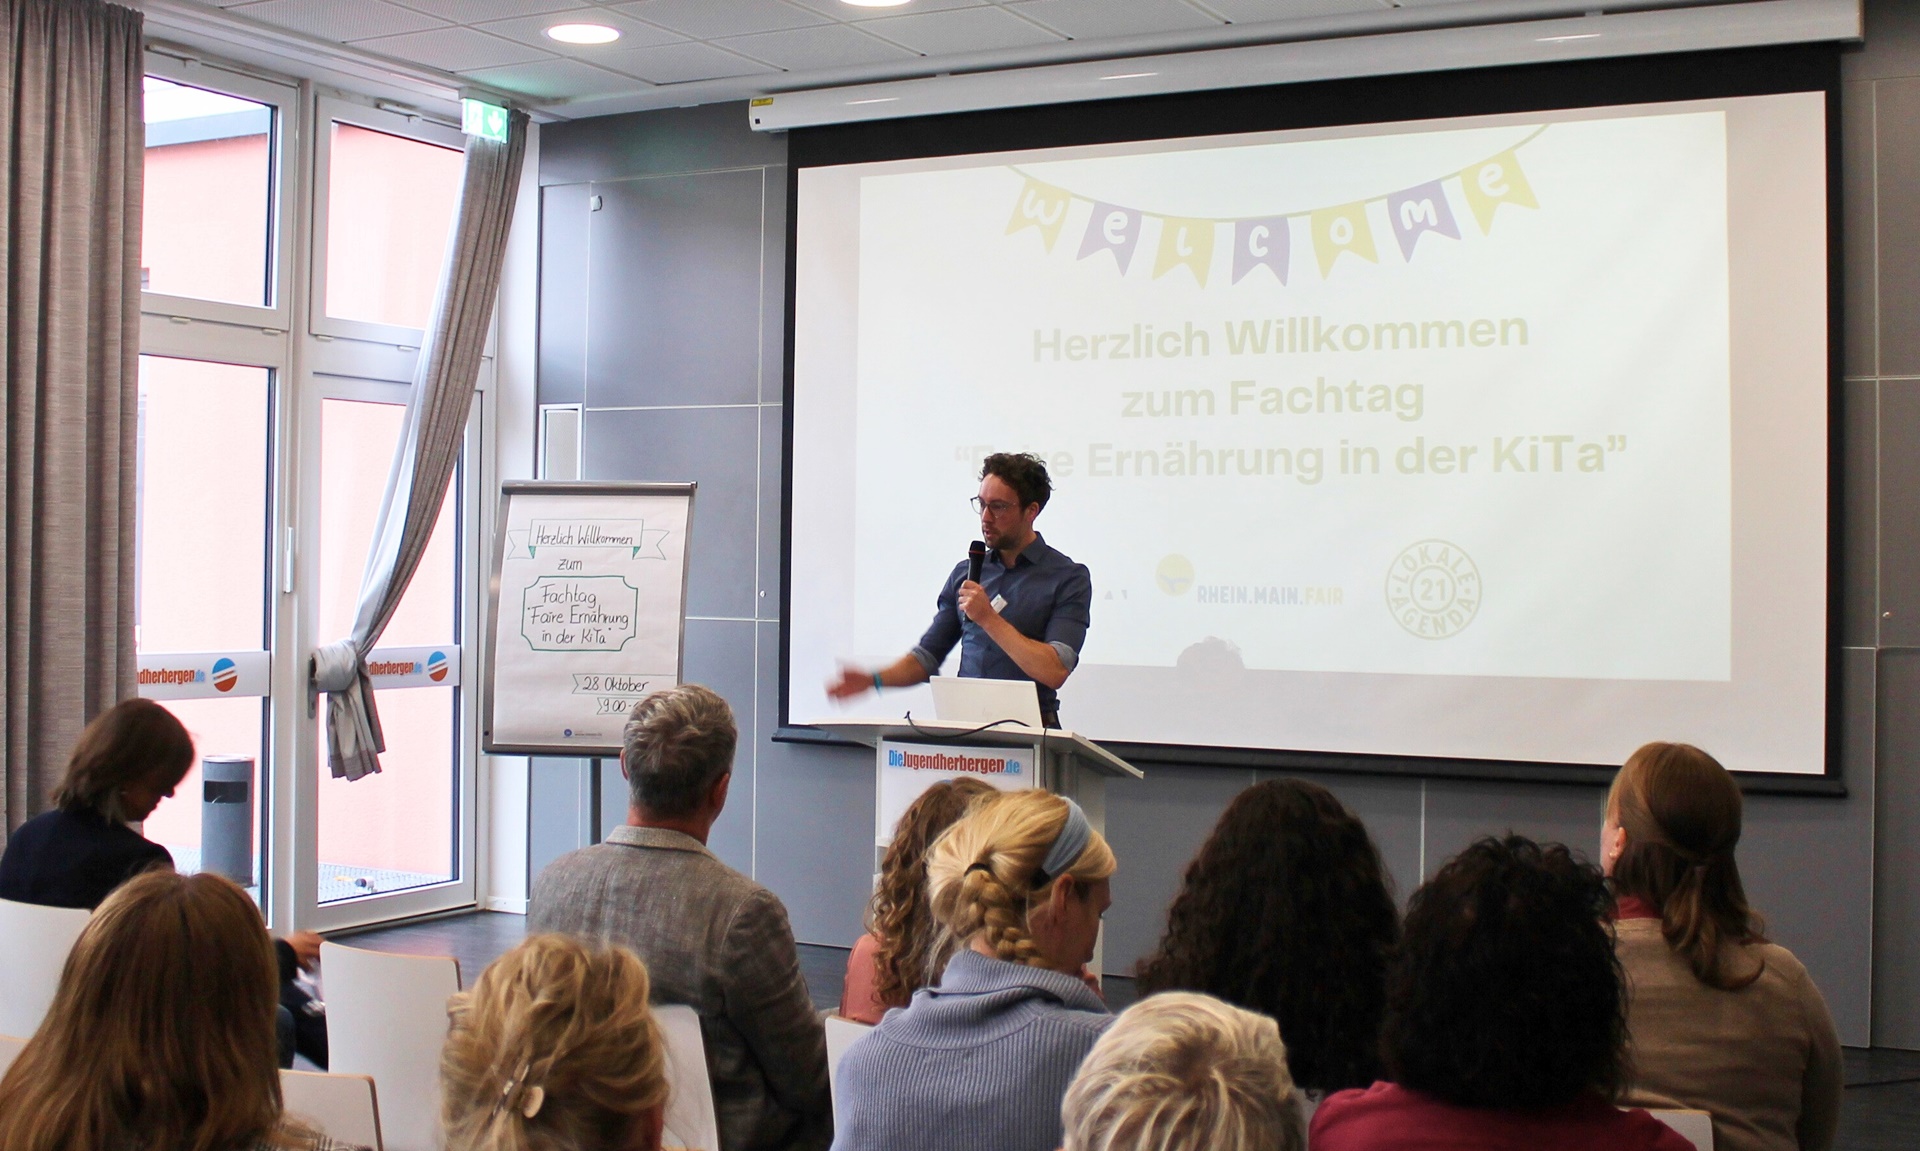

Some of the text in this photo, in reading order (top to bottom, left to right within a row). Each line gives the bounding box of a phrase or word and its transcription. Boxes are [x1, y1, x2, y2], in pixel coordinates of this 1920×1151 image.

[1032, 315, 1529, 363] Herzlich Willkommen
[1120, 376, 1425, 423] zum Fachtag
[1087, 440, 1325, 486] Ernährung
[1339, 438, 1380, 475] in
[1394, 435, 1478, 475] der
[536, 524, 634, 546] Herzlich Willkommen
[557, 558, 583, 571] zum
[1391, 545, 1476, 586] LOKALE
[540, 583, 597, 609] Fachtag
[1197, 585, 1344, 606] RHEIN.MAIN.FAIR
[1420, 578, 1446, 602] 21
[569, 604, 629, 630] Ernährung
[1391, 596, 1476, 635] AGENDA
[542, 629, 552, 643] in
[556, 628, 576, 644] der
[604, 676, 650, 692] Oktober
[888, 749, 1021, 774] DieJugendherbergen.de
